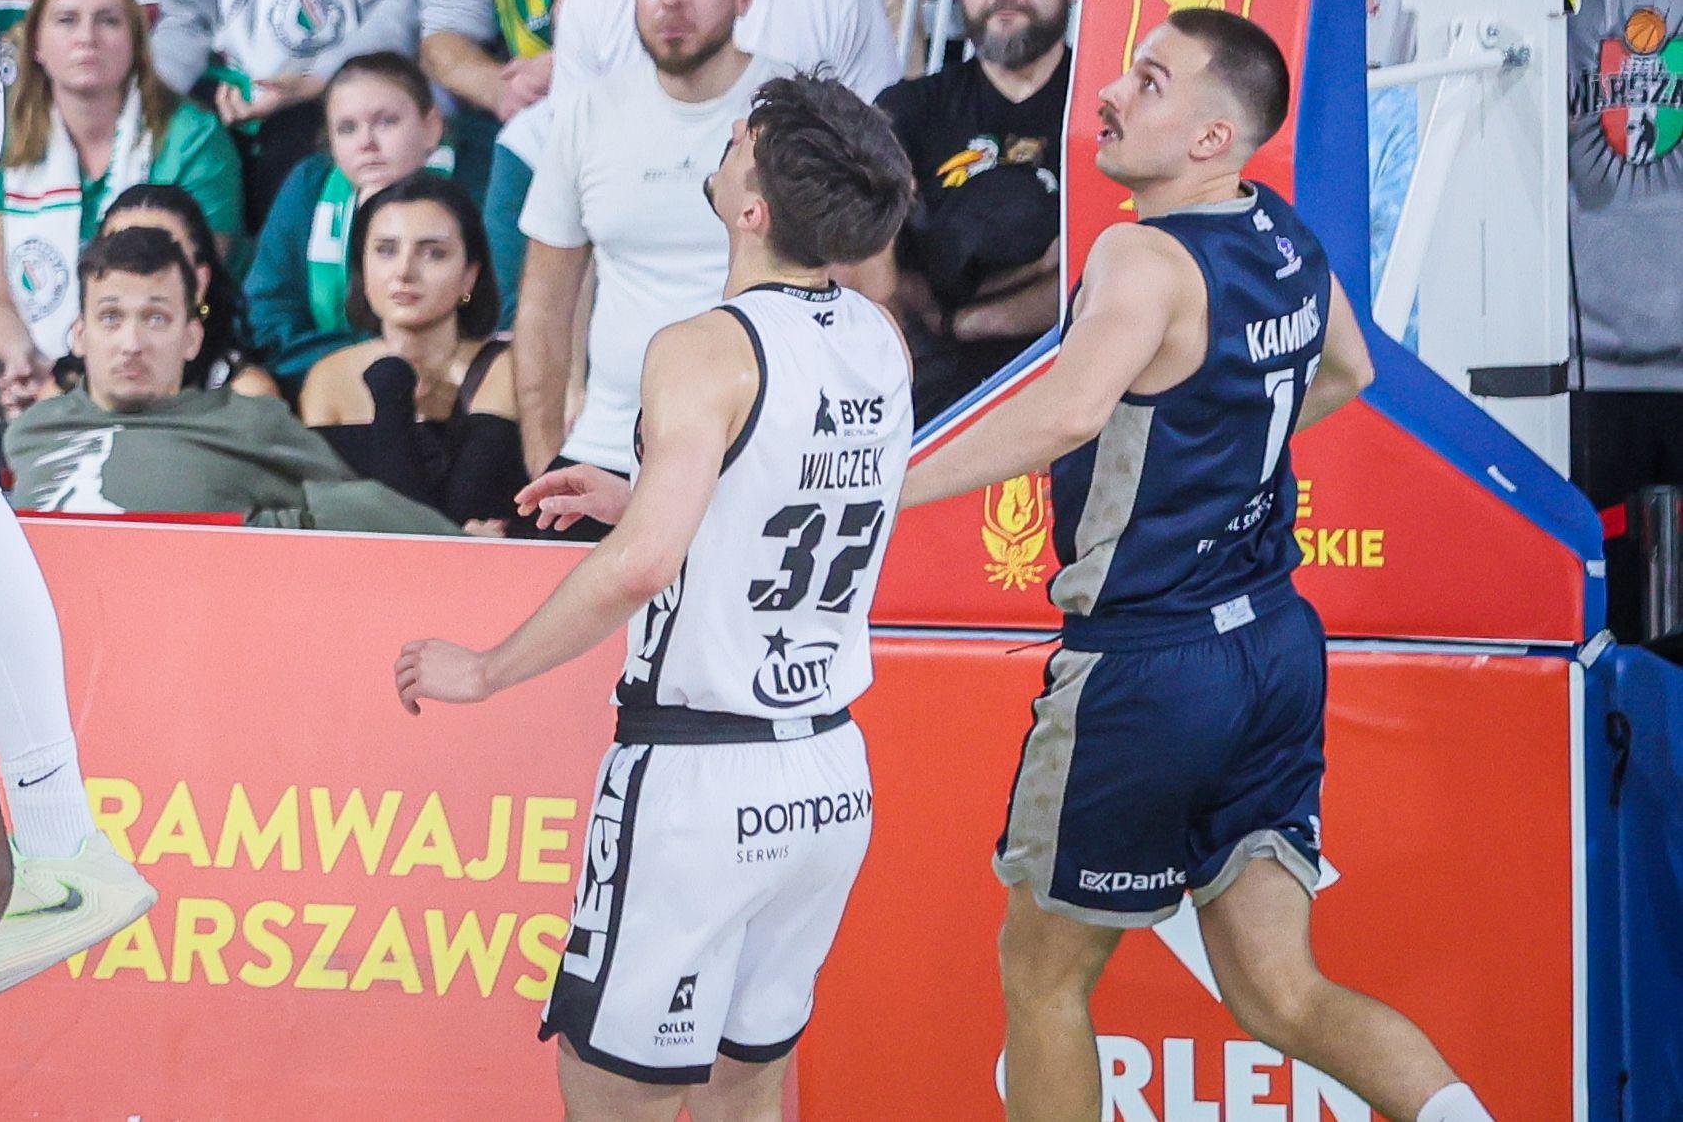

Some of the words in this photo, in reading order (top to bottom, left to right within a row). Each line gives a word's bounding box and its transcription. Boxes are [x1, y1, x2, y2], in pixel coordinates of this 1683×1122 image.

[798, 447, 885, 490] WILCZEK
[747, 500, 885, 613] 32
[736, 845, 790, 863] SERWIS
[995, 1035, 1372, 1122] RLEN
